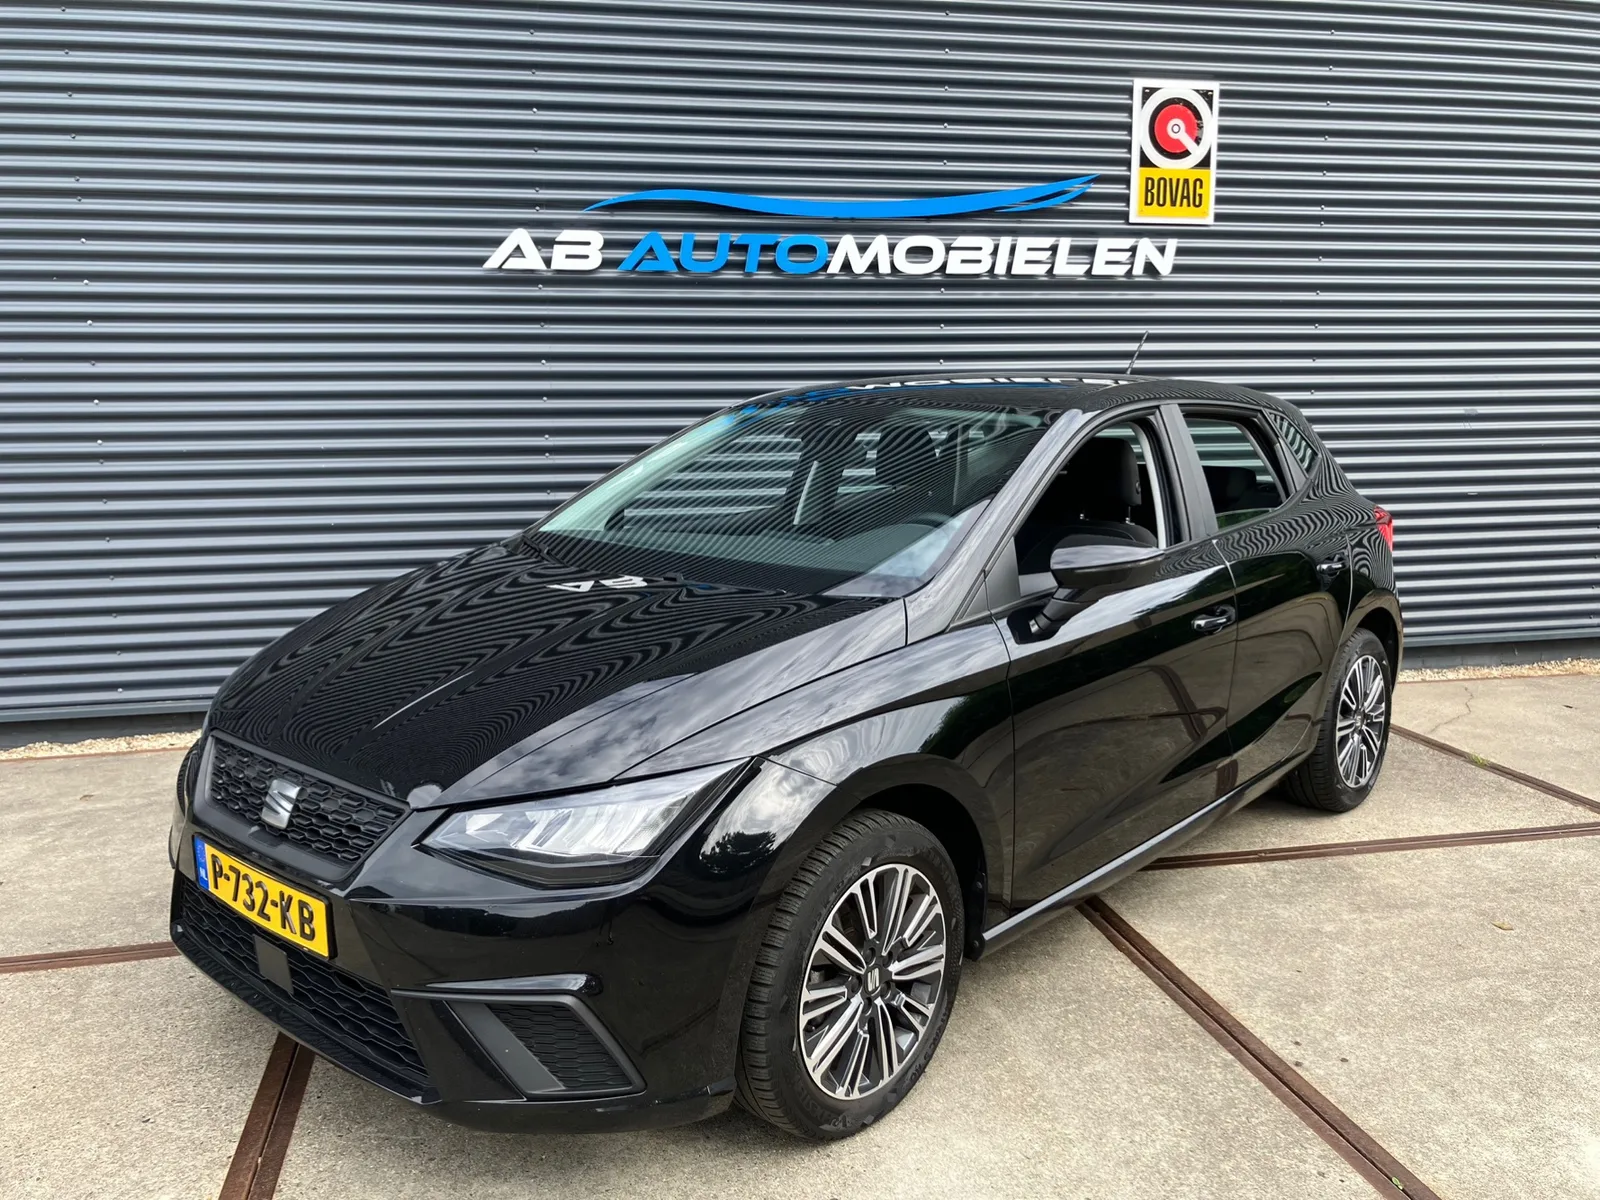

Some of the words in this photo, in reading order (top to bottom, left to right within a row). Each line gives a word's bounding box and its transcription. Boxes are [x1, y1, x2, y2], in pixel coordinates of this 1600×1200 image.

[1144, 177, 1204, 208] BOVAG
[482, 228, 605, 271] AB
[616, 231, 1178, 276] AUTOMOBIELEN
[211, 853, 316, 942] P-732-KB
